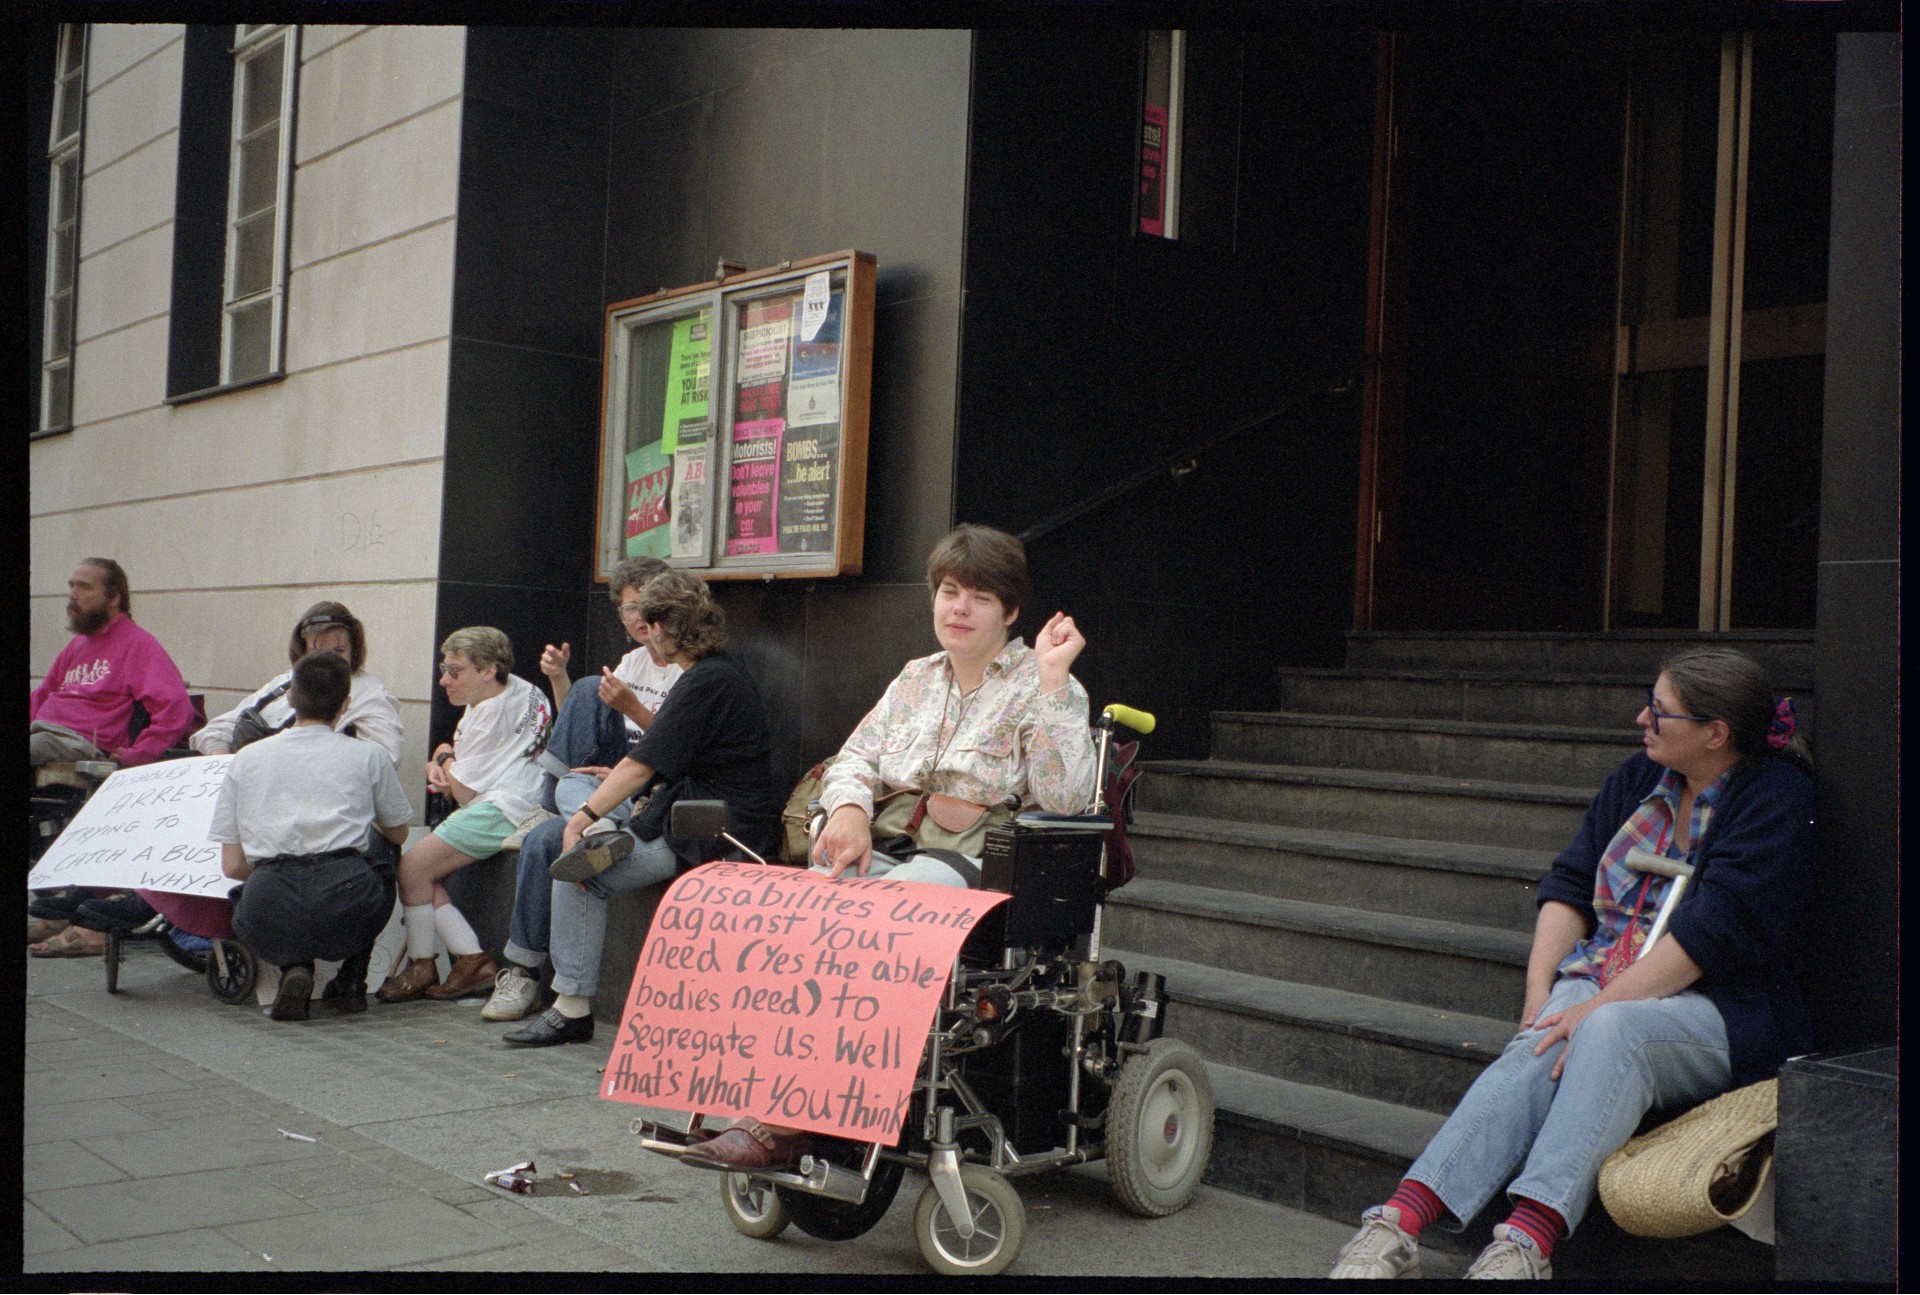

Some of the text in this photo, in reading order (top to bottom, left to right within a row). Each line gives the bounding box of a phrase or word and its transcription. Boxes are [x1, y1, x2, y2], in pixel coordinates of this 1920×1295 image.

[681, 377, 697, 391] YOU
[681, 391, 691, 405] AT
[786, 439, 828, 461] BOMBS...
[751, 463, 775, 479] leave
[808, 461, 831, 482] alert
[732, 482, 769, 498] valuables
[735, 499, 763, 516] in your
[740, 518, 755, 533] car
[201, 760, 231, 776] PE
[60, 814, 180, 847] TRYING TO
[53, 848, 128, 873] CATCH
[132, 845, 154, 862] A
[140, 871, 222, 895] WHY?
[660, 905, 809, 941] against
[889, 899, 976, 931] Unite
[813, 949, 860, 980] the
[871, 951, 946, 990] able-
[635, 974, 881, 1023] bodies need) to
[622, 1012, 758, 1062] Segregate
[835, 1026, 902, 1070] Well
[613, 1053, 683, 1098] that's
